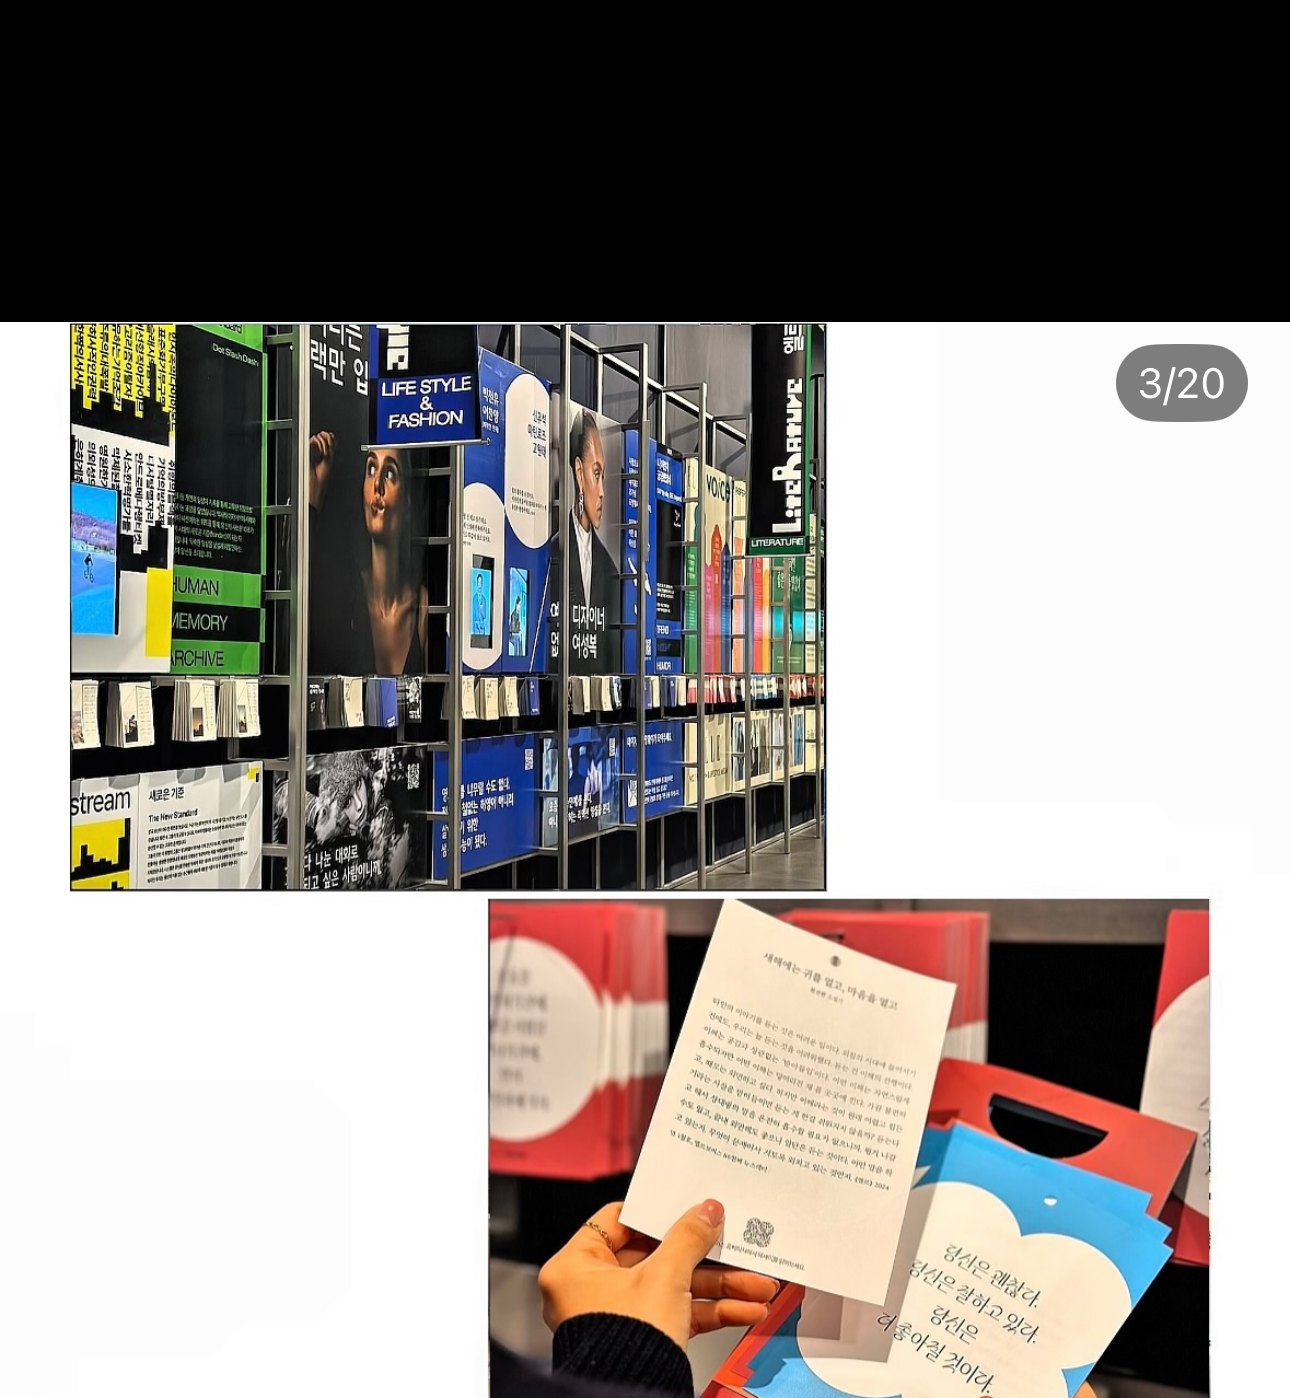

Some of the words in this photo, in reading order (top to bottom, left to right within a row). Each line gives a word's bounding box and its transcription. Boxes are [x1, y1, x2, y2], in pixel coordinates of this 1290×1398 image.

[212, 342, 225, 355] Dot
[381, 380, 417, 397] LIFE
[420, 375, 472, 394] STYLE
[420, 396, 433, 410] &
[388, 409, 464, 429] FASHION
[751, 537, 804, 548] LITERATURE
[173, 576, 219, 596] HUMAN
[573, 604, 605, 632] 디자이너
[572, 632, 597, 659] 여성복
[71, 791, 130, 816] stream
[171, 786, 184, 800] 기준
[149, 814, 159, 823] The
[315, 850, 331, 869] 나눈
[335, 845, 358, 863] 대화로
[323, 870, 339, 889] 싶은
[944, 1243, 990, 1279] 당신은
[991, 1269, 1041, 1309] 괜찮다.
[910, 1259, 956, 1294] 당신은
[957, 1284, 1003, 1321] 잘하고
[1003, 1312, 1039, 1343] 있다.
[931, 1305, 979, 1344] 당신은
[877, 1312, 897, 1332] 더
[893, 1322, 946, 1362] 좋아질
[942, 1352, 994, 1393] 것이다.
